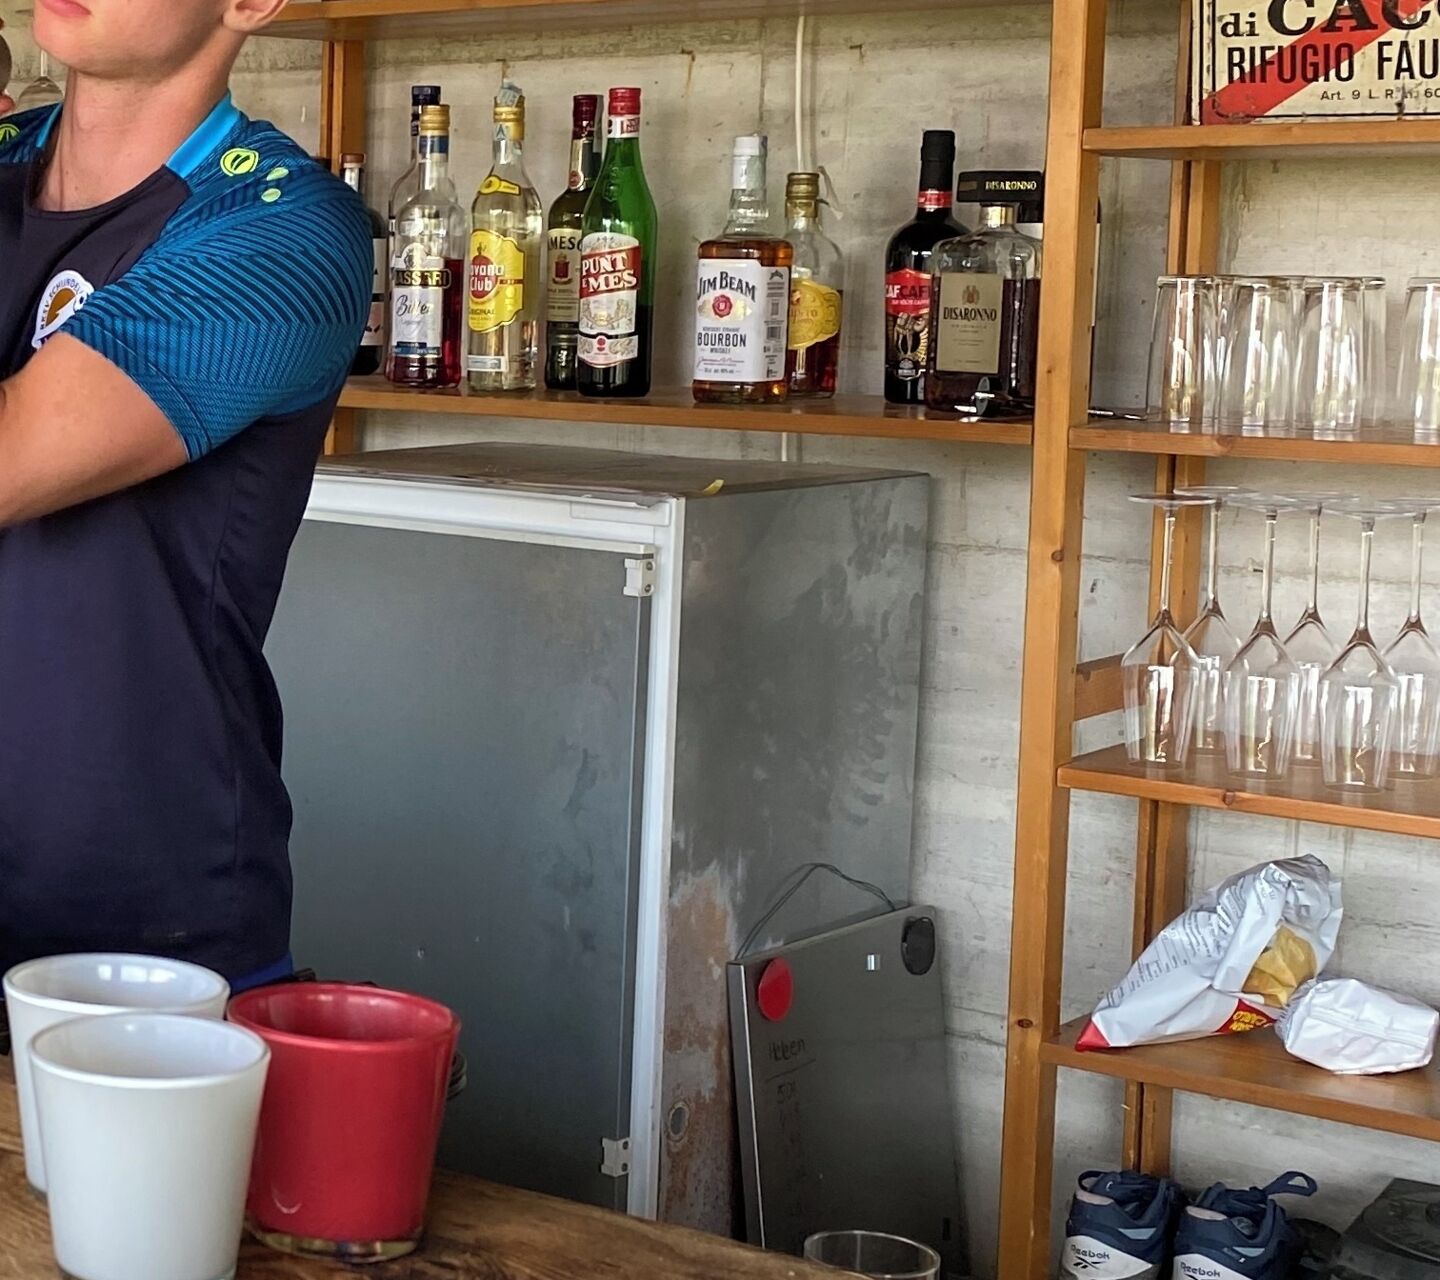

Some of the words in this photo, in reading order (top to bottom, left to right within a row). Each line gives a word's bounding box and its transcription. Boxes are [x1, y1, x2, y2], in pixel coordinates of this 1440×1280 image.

[1220, 12, 1259, 37] di
[1227, 42, 1355, 84] RIFUGIO
[1351, 89, 1361, 100] 9
[985, 180, 1037, 191] DISARONNO
[582, 251, 627, 276] PUNT
[588, 269, 637, 292] MES
[696, 276, 717, 301] JIM
[719, 271, 756, 303] BEAM
[943, 306, 997, 322] DISARONNO
[697, 332, 747, 348] BOURBON
[1071, 1244, 1111, 1260] Reebok
[1180, 1261, 1221, 1278] Reebok
